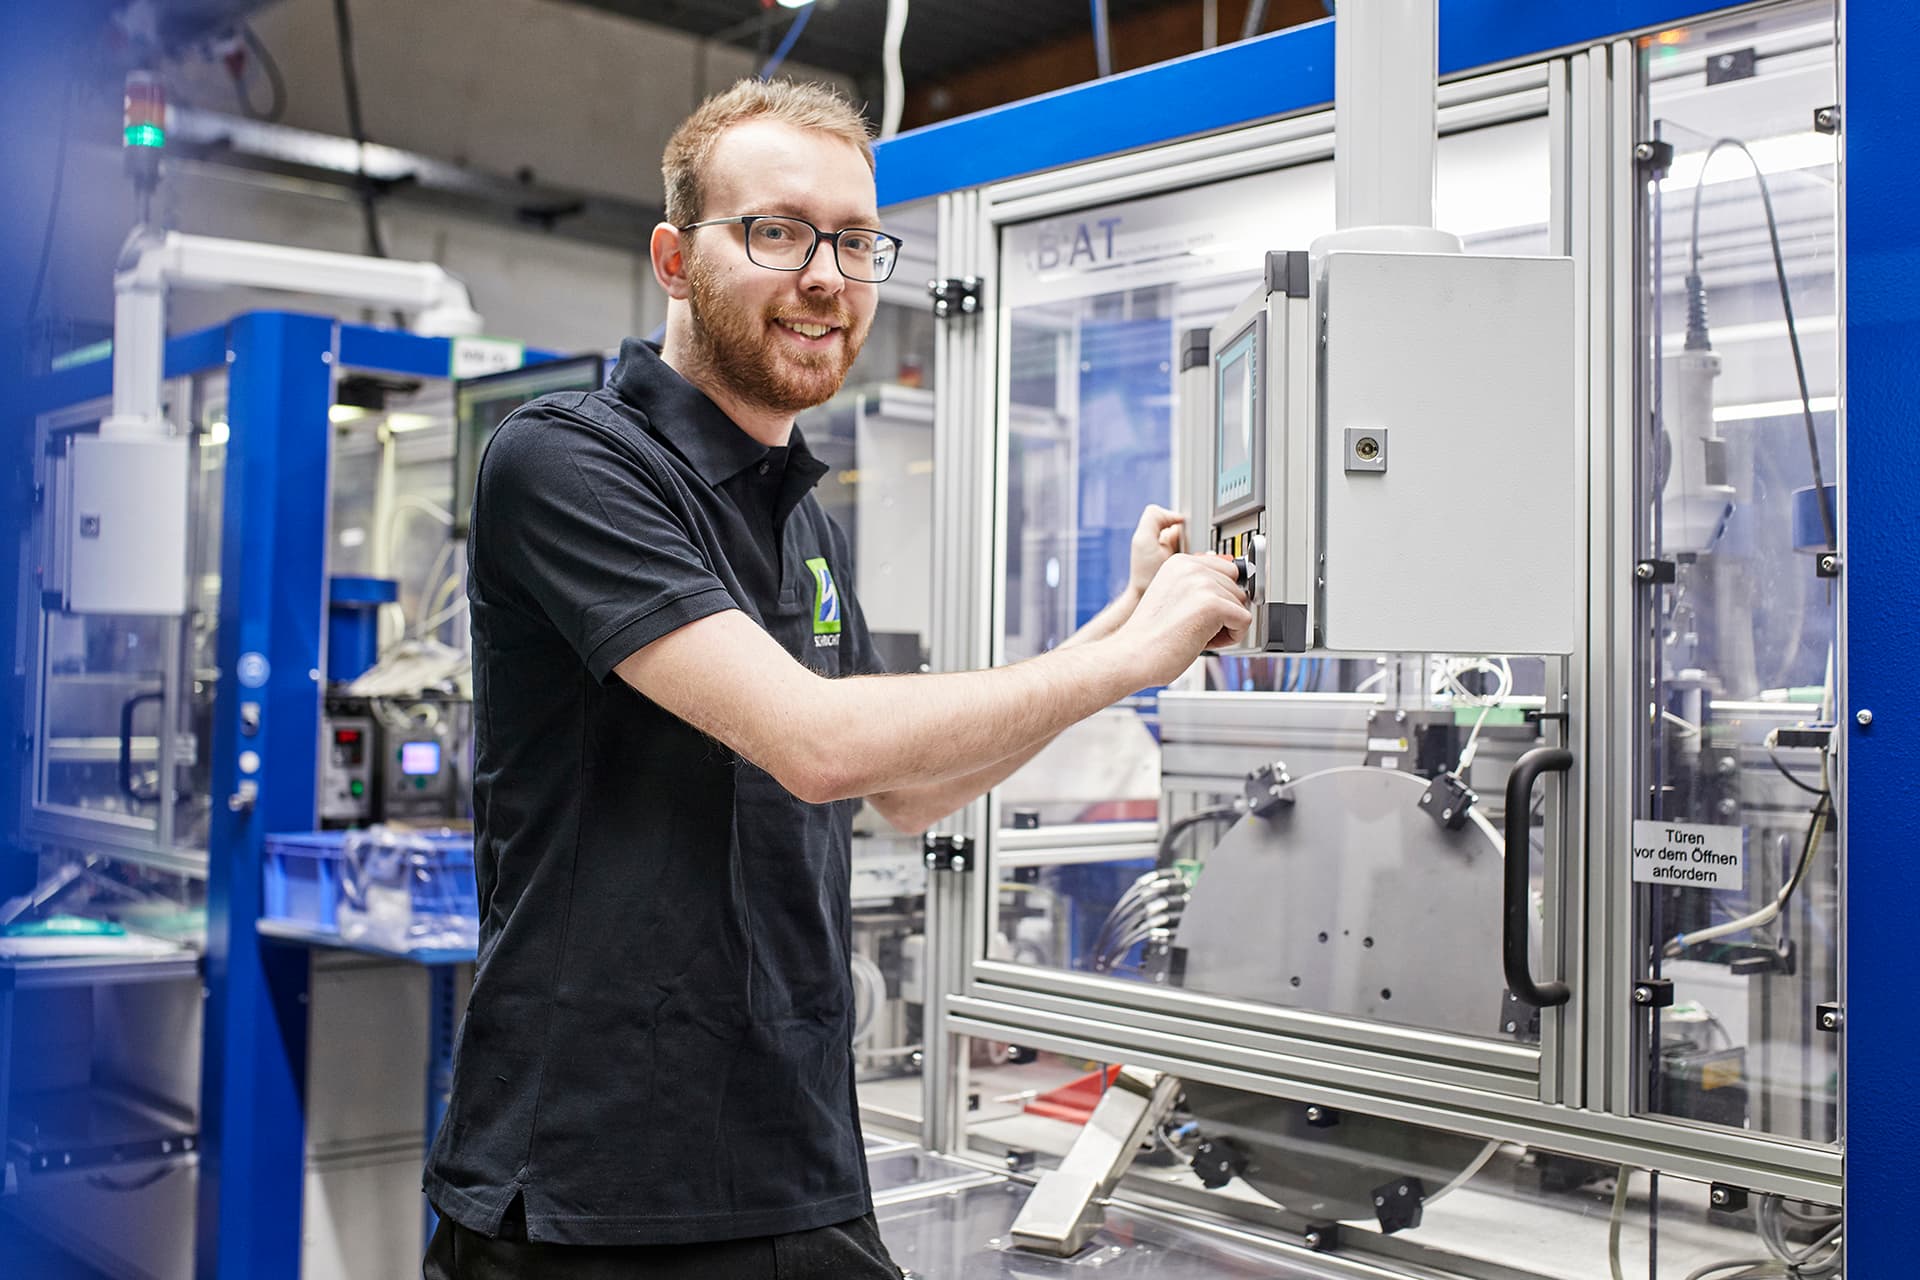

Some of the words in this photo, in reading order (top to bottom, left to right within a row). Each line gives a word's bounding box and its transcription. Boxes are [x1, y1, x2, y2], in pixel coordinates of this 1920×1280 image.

[1665, 829, 1705, 845] Türen
[1634, 848, 1655, 859] vor
[1658, 847, 1687, 861] dem
[1691, 848, 1737, 866] Öffnen
[1652, 865, 1717, 882] anfordern
